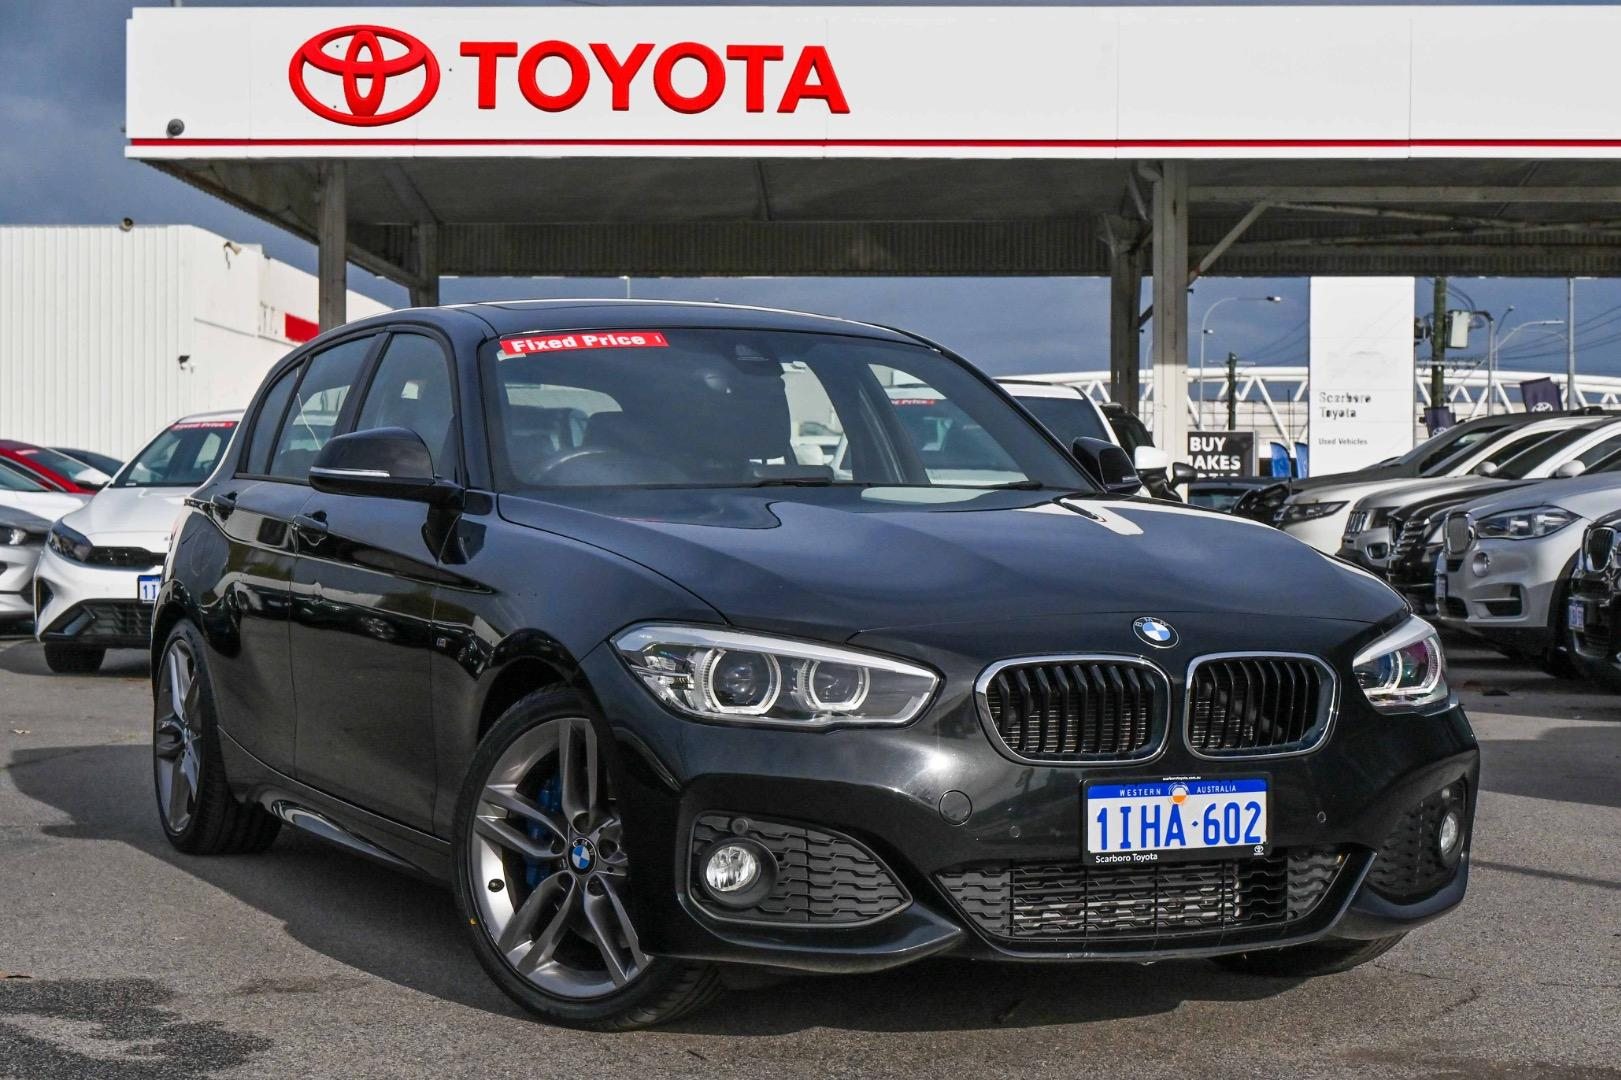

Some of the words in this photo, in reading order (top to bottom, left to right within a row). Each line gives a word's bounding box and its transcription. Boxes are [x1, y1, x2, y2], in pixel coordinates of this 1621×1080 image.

[460, 40, 850, 114] TOYOTA
[511, 336, 578, 352] Fixed
[581, 334, 646, 347] Price
[1320, 407, 1357, 420] Toyota
[1189, 436, 1226, 452] BUY
[1119, 788, 1161, 797] WESTERN
[1197, 785, 1237, 793] AUSTRALIA
[1095, 854, 1131, 864] Scarboro
[1133, 853, 1158, 862] Toyota
